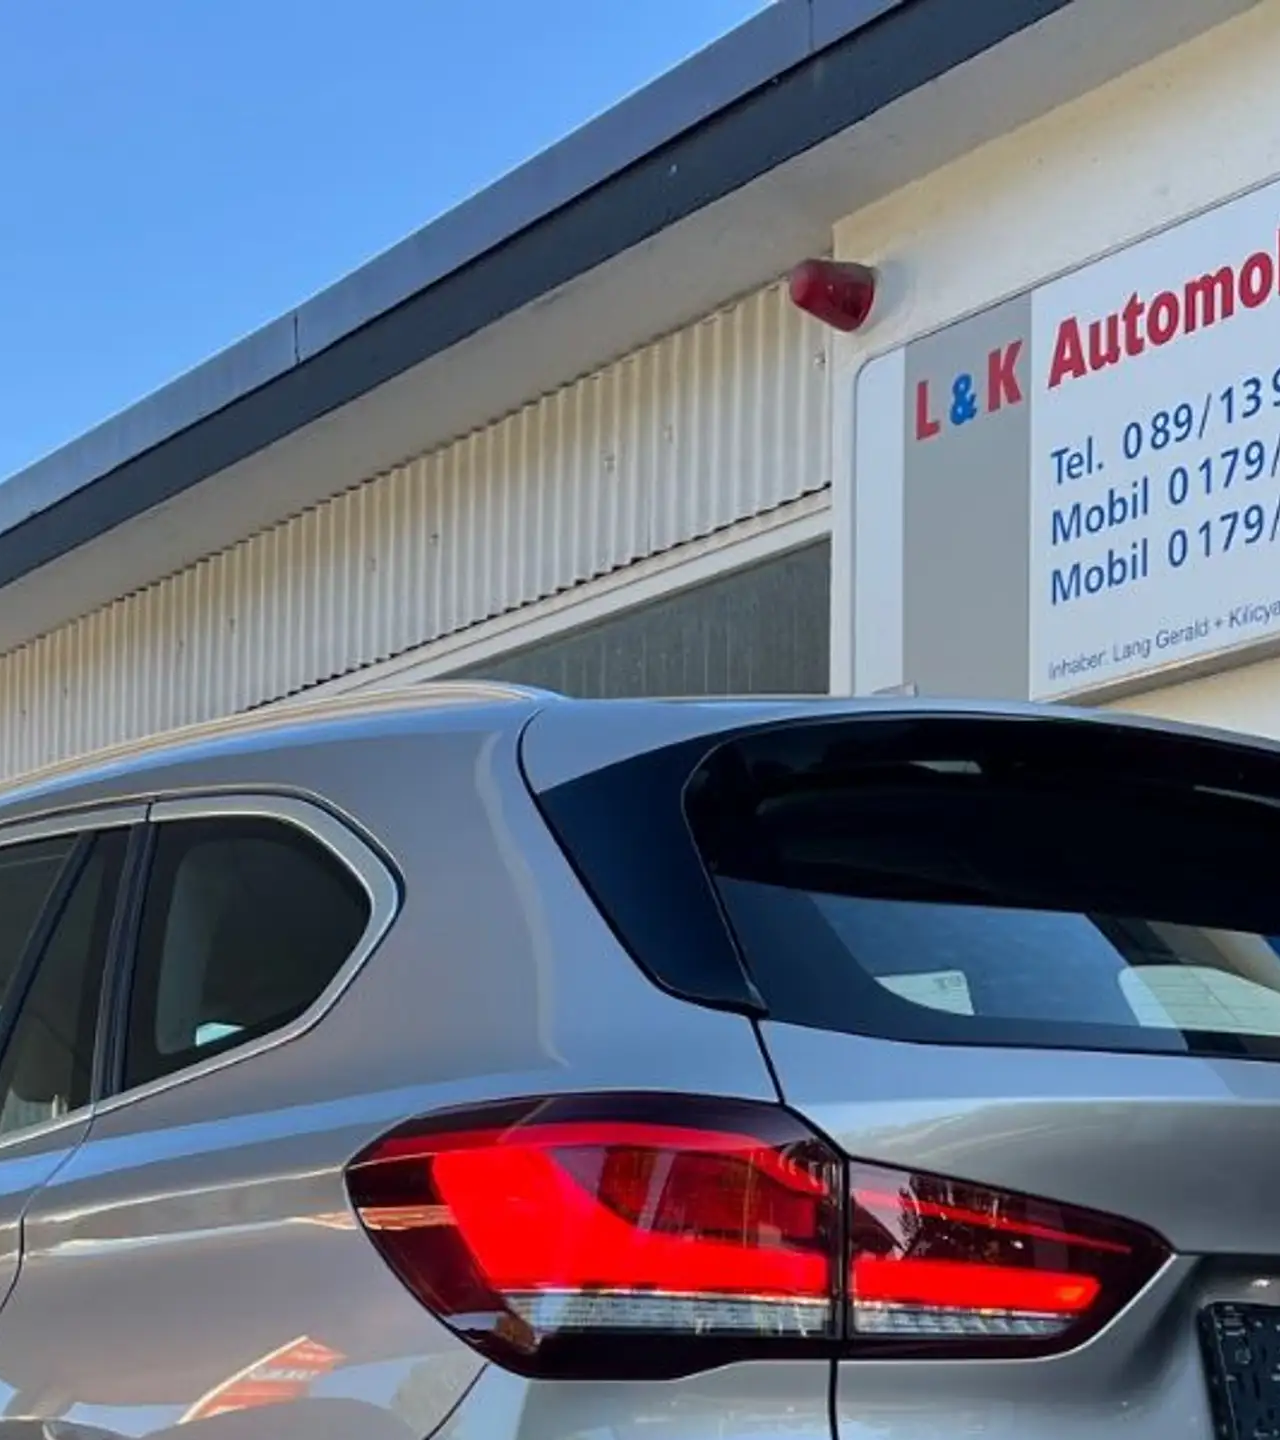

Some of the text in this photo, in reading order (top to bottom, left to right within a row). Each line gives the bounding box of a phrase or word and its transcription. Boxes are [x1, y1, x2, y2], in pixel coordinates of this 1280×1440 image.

[914, 379, 939, 440] L
[949, 372, 978, 425] &
[987, 340, 1023, 411] K
[1051, 436, 1104, 486] Tel.
[1051, 475, 1149, 546] Mobil
[1051, 537, 1149, 606] Mobil
[1112, 637, 1152, 663] Lang
[1156, 618, 1209, 650] Gerald
